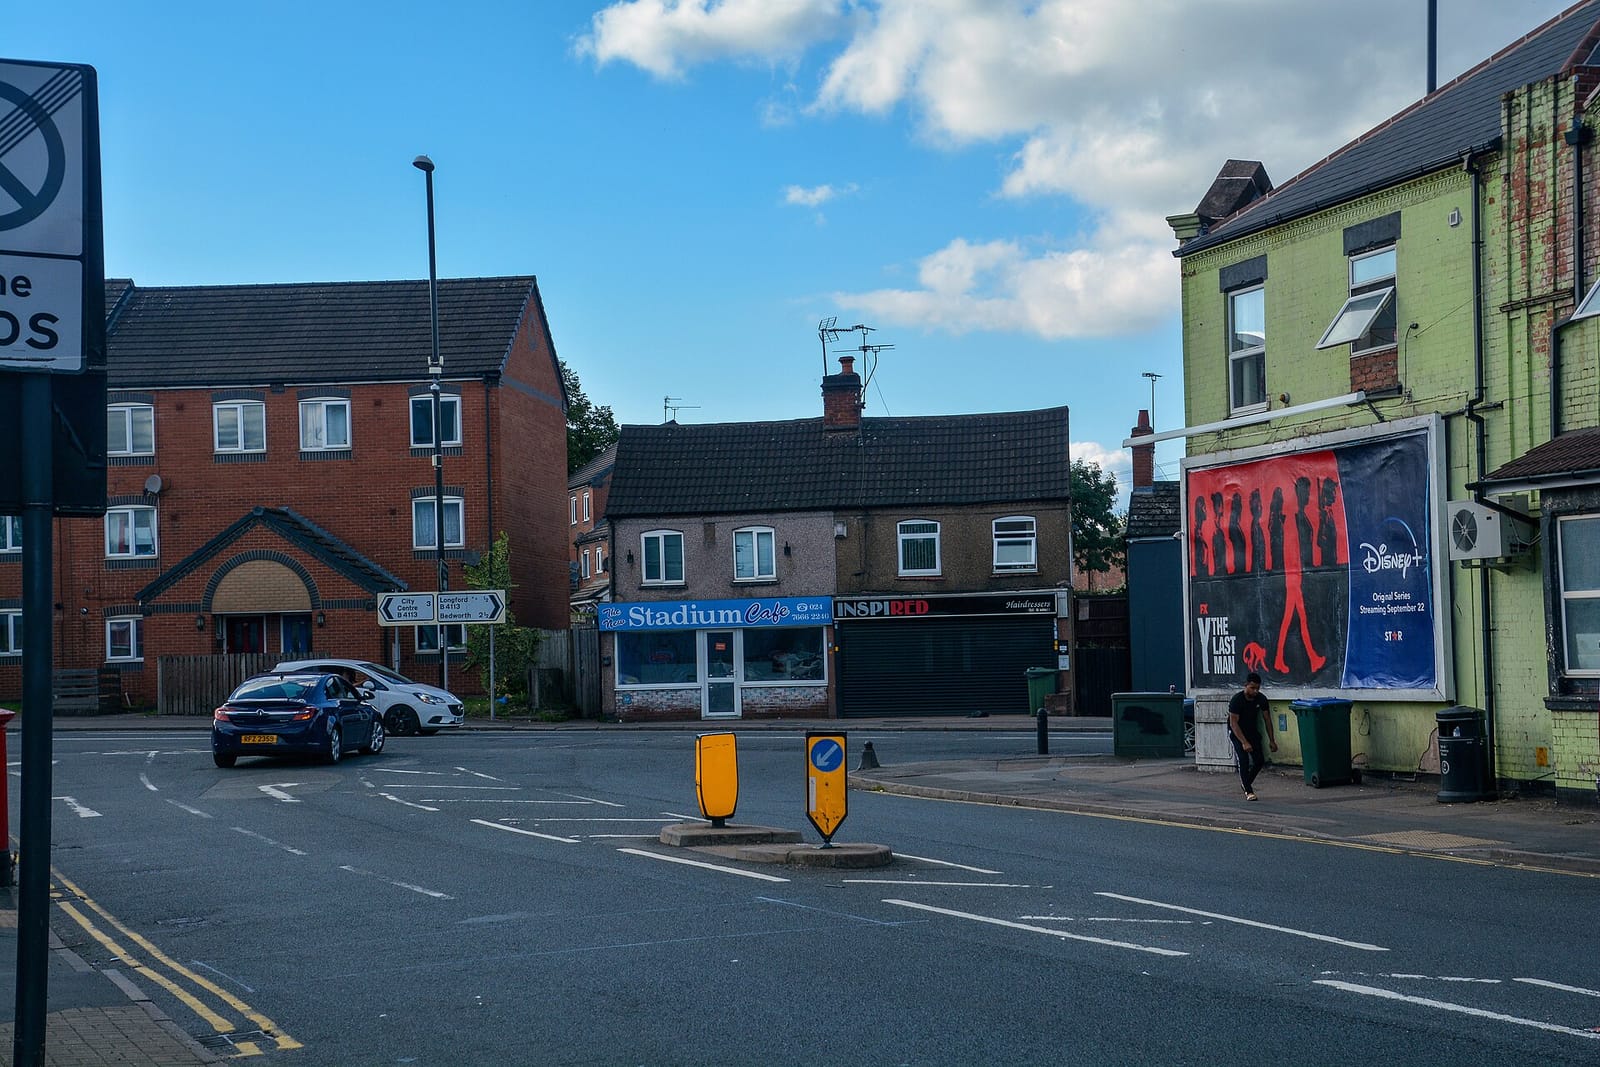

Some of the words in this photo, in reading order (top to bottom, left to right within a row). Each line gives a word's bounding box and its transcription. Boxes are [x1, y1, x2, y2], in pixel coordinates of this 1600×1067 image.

[1373, 592, 1394, 603] Original
[1394, 591, 1411, 601] Series
[602, 607, 621, 618] The
[629, 604, 743, 627] Stadium
[744, 601, 790, 624] Cafe
[810, 603, 823, 611] 024
[837, 600, 929, 617] INSPIRED
[1360, 604, 1387, 615] Streaming
[1386, 603, 1416, 615] September
[1417, 602, 1425, 611] 22
[602, 618, 626, 630] New
[1211, 616, 1229, 635] THE
[1197, 617, 1211, 674] Y
[1213, 635, 1236, 655] LAST
[1213, 655, 1235, 674] MAN
